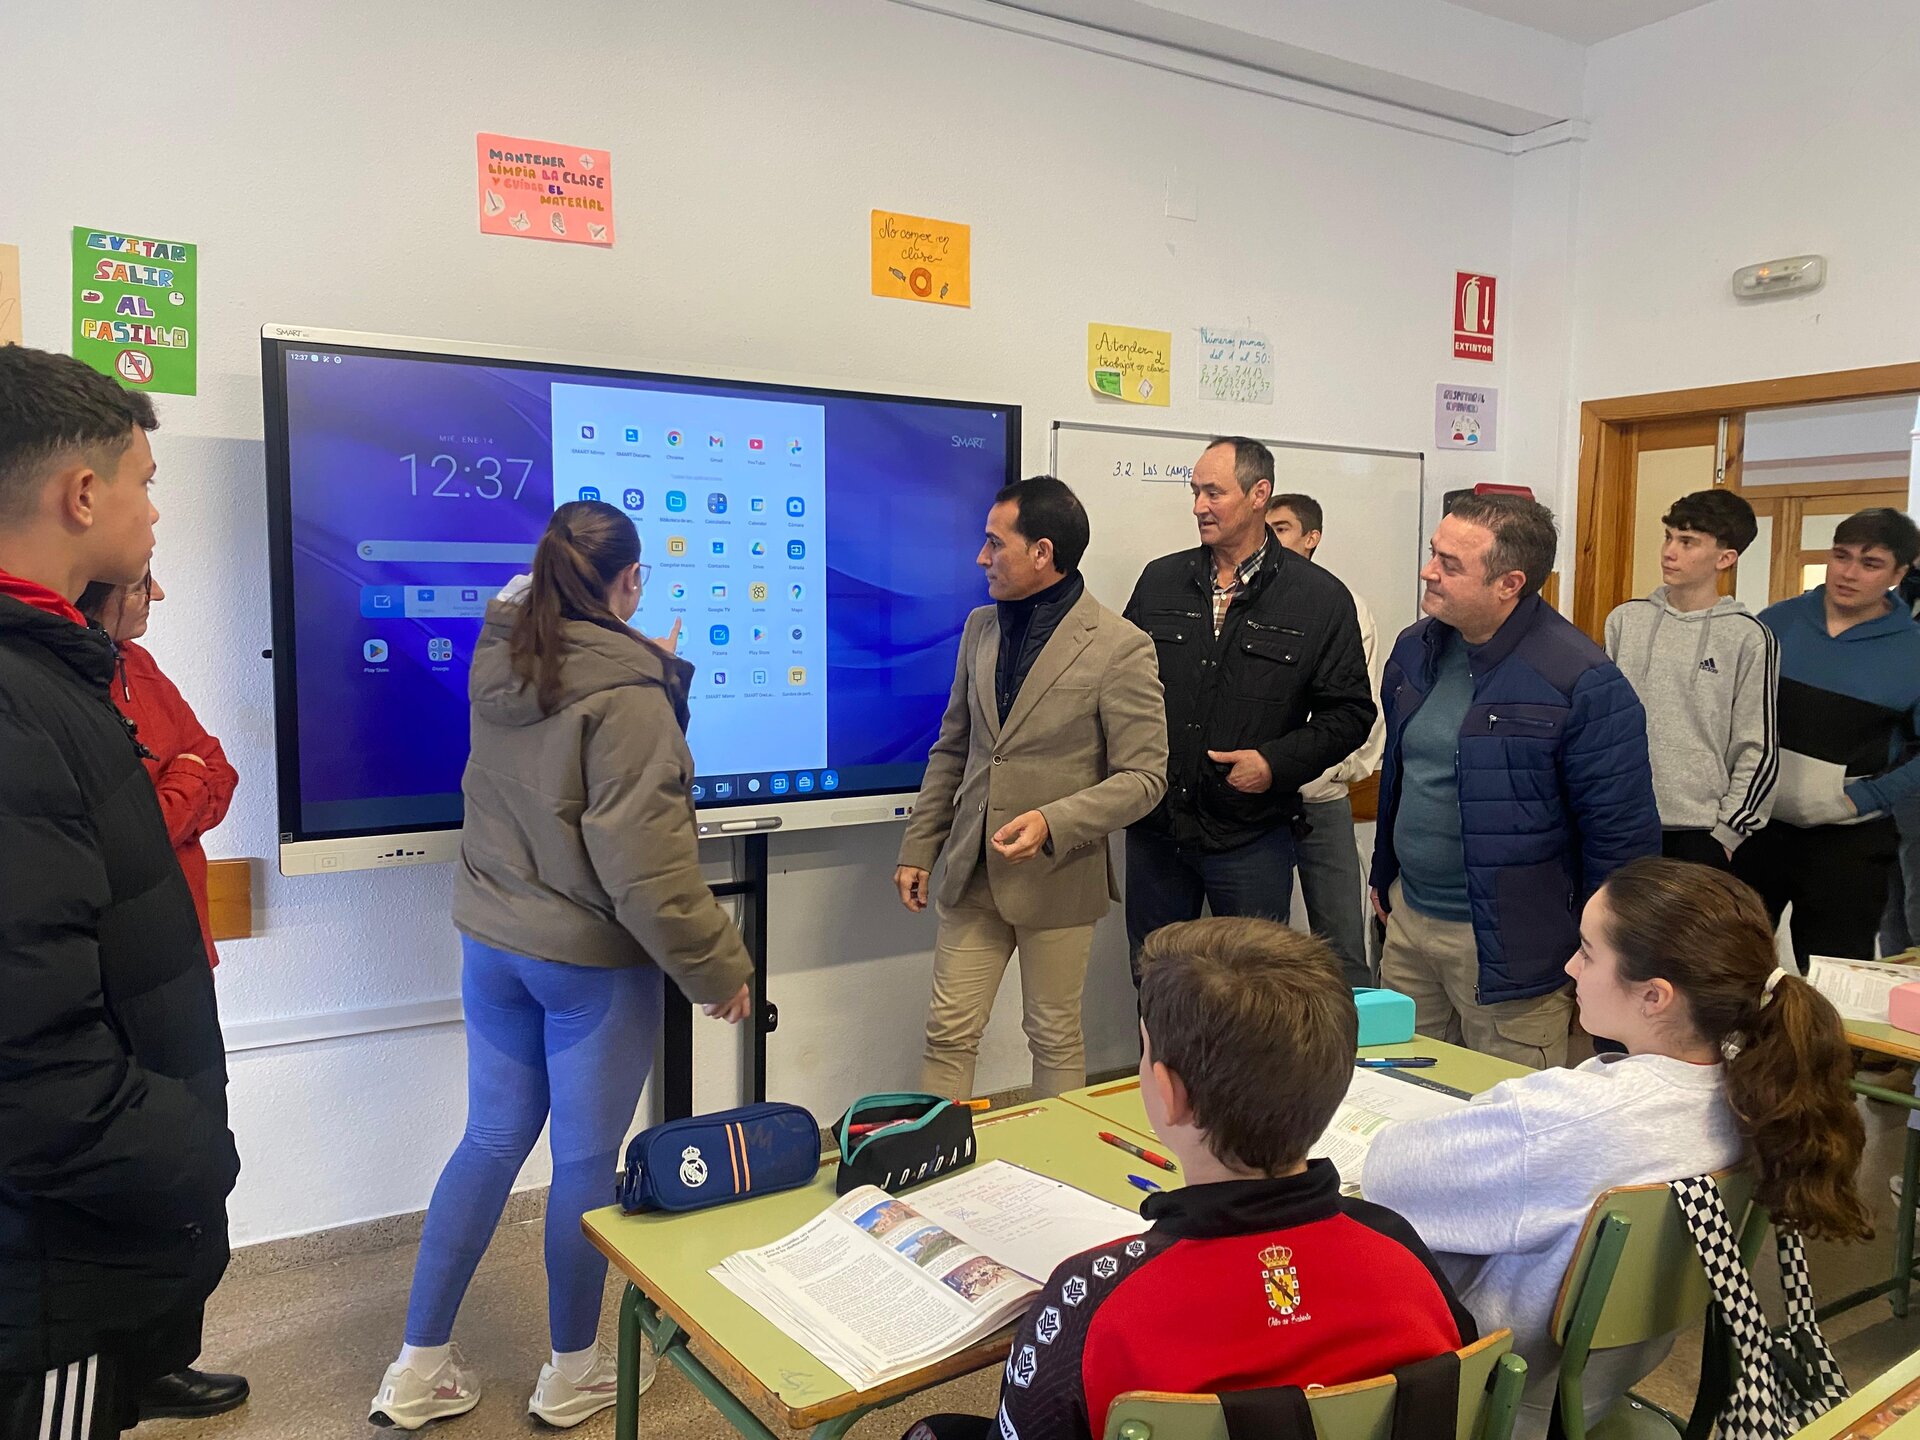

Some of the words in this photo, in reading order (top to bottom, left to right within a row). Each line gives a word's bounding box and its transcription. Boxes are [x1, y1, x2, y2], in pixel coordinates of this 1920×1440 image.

[489, 148, 565, 168] MANTENER
[492, 177, 500, 186] Y
[503, 178, 545, 193] CUIDAR
[548, 184, 564, 195] EL
[541, 169, 559, 181] LA
[562, 171, 604, 189] CLASE
[540, 195, 604, 212] MATERIAL
[879, 217, 899, 239] No
[900, 229, 934, 252] comer
[87, 233, 186, 262] EVITAR
[95, 260, 174, 287] SALIR
[116, 296, 154, 316] AL
[83, 319, 187, 348] PASILLO
[276, 328, 302, 337] SMART
[290, 353, 308, 361] 12:37
[1096, 332, 1153, 361] Atender
[1155, 350, 1165, 365] y
[1210, 349, 1224, 360] del
[1455, 341, 1492, 354] EXTINTOR
[462, 436, 479, 444] ENE
[482, 437, 493, 445] 14
[951, 435, 986, 449] SMART
[399, 453, 533, 501] 12:37
[1165, 464, 1193, 485] CAMPE
[880, 1136, 972, 1190] JORDAN
